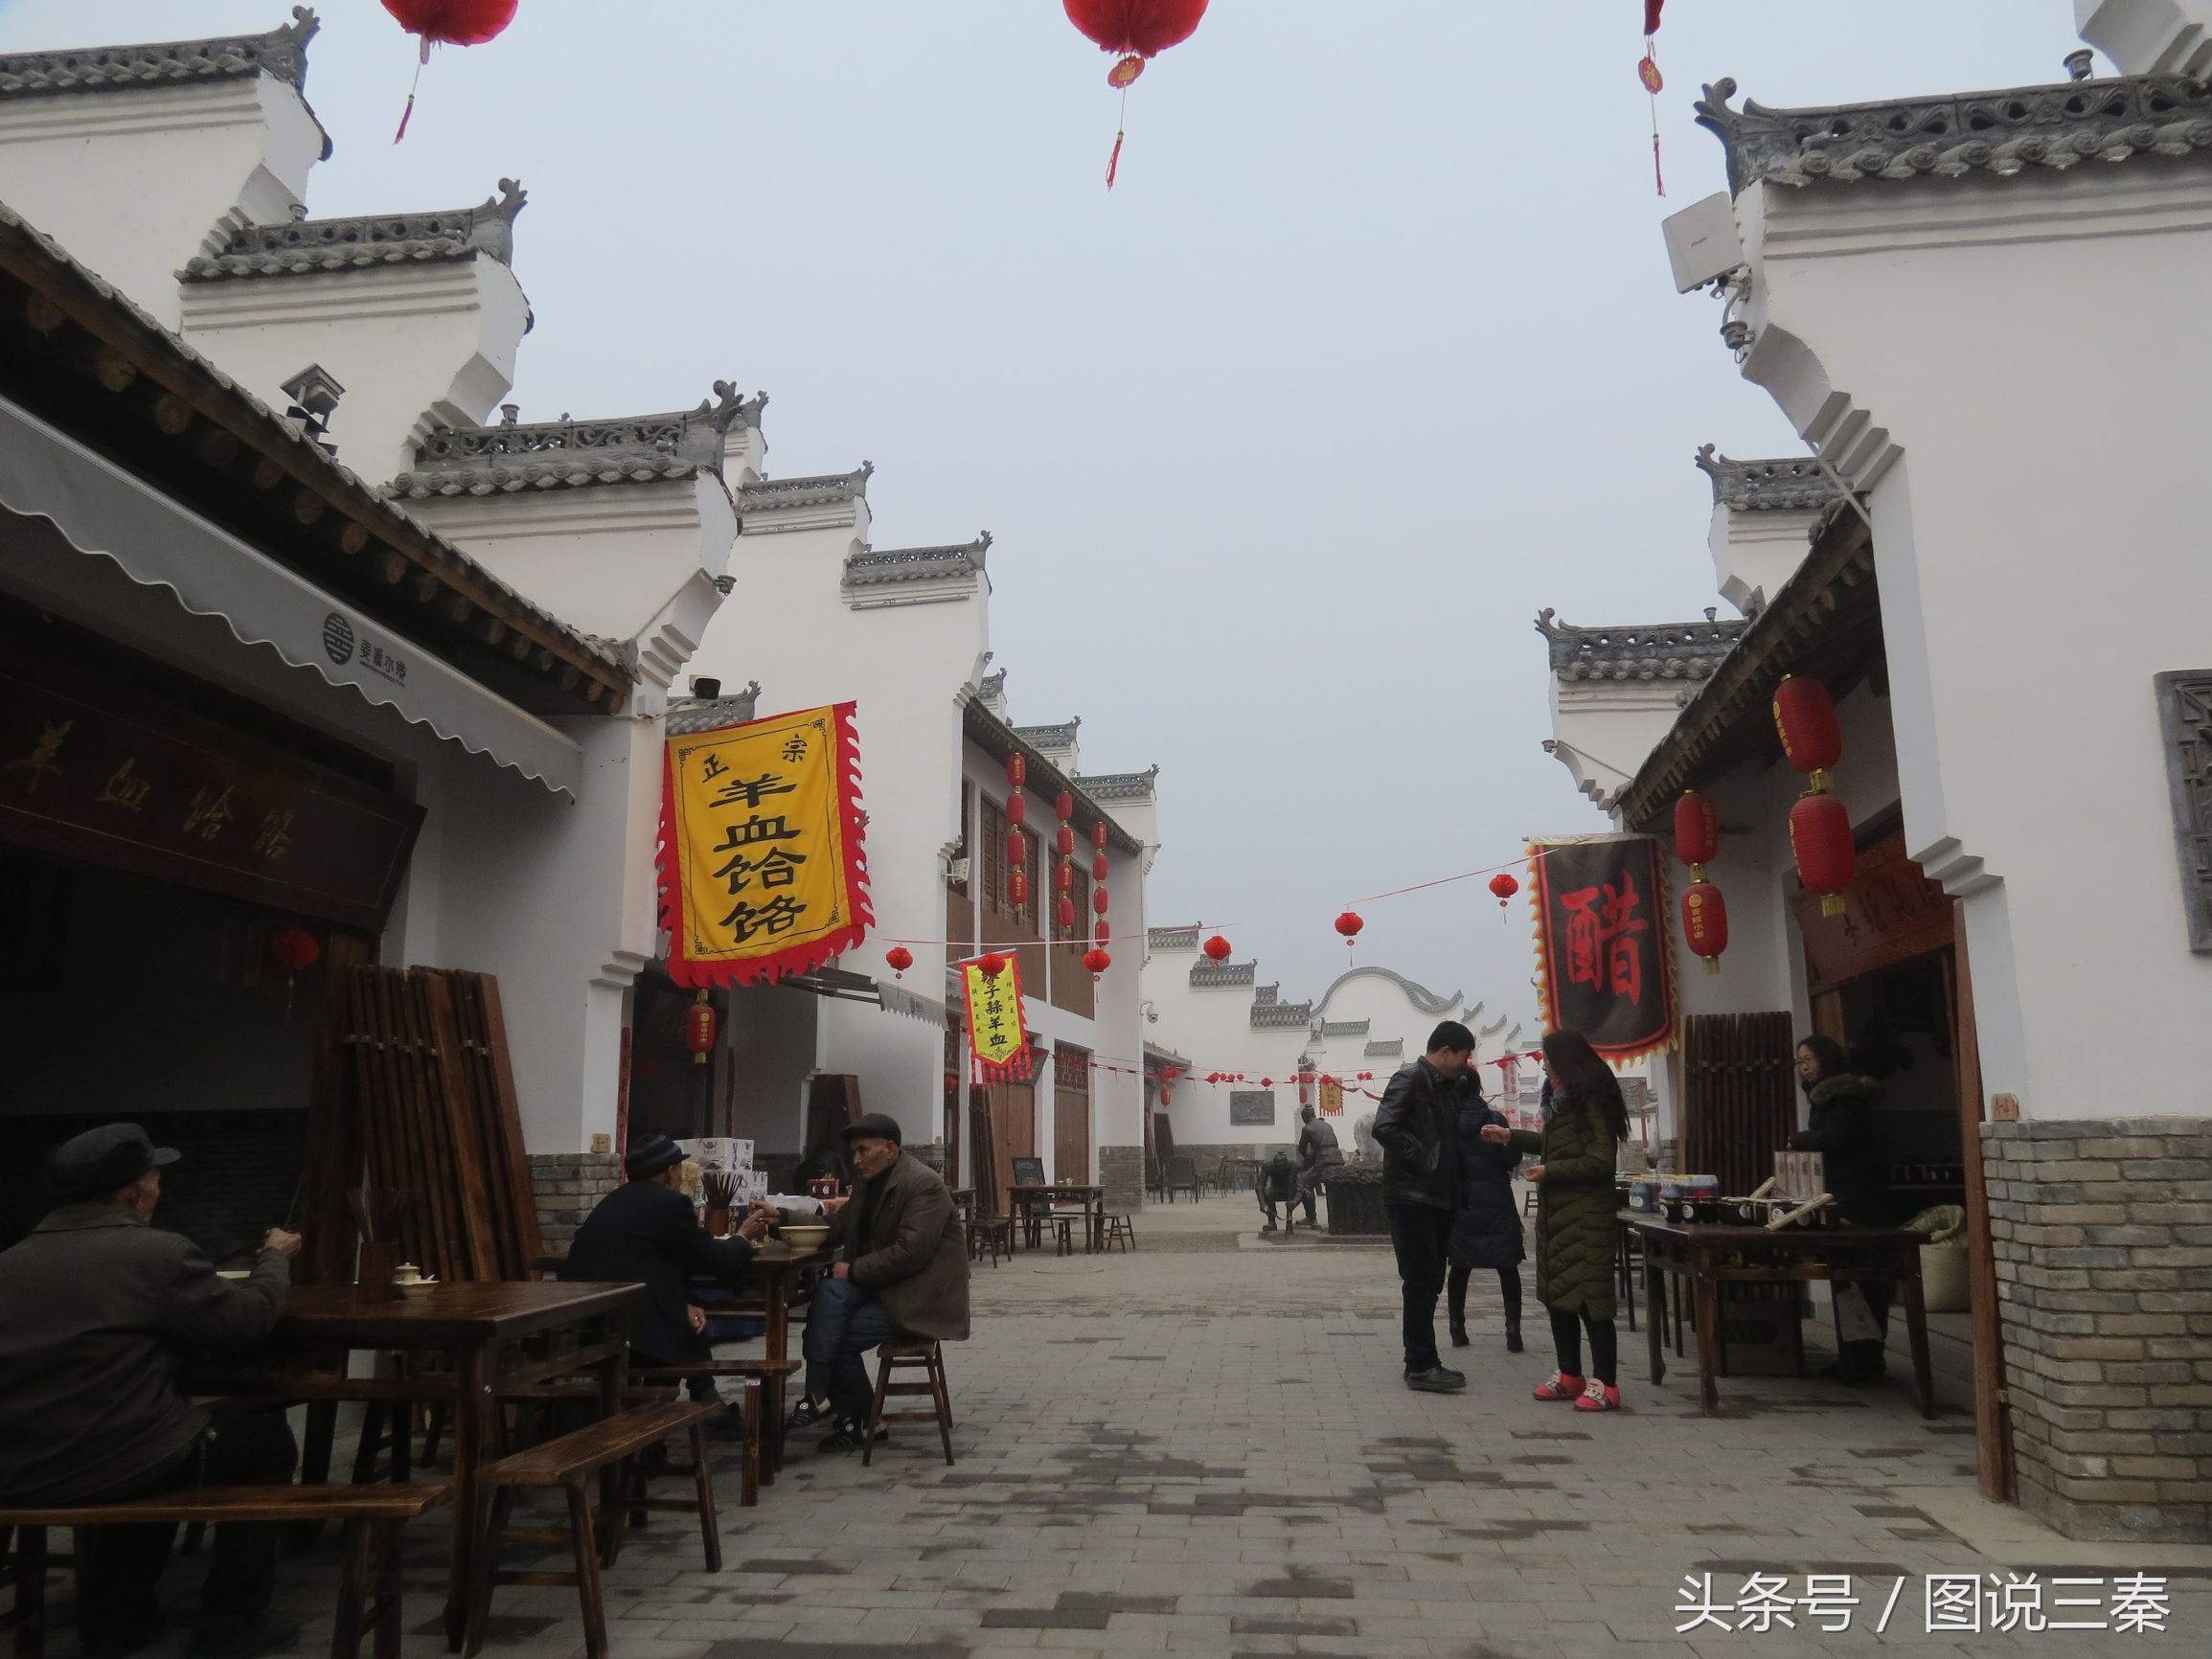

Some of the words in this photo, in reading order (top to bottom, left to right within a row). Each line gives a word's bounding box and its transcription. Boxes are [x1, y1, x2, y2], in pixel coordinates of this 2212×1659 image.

[702, 734, 808, 784] 正宗
[709, 773, 807, 943] 羊血饸饹
[1560, 868, 1649, 1006] 醋
